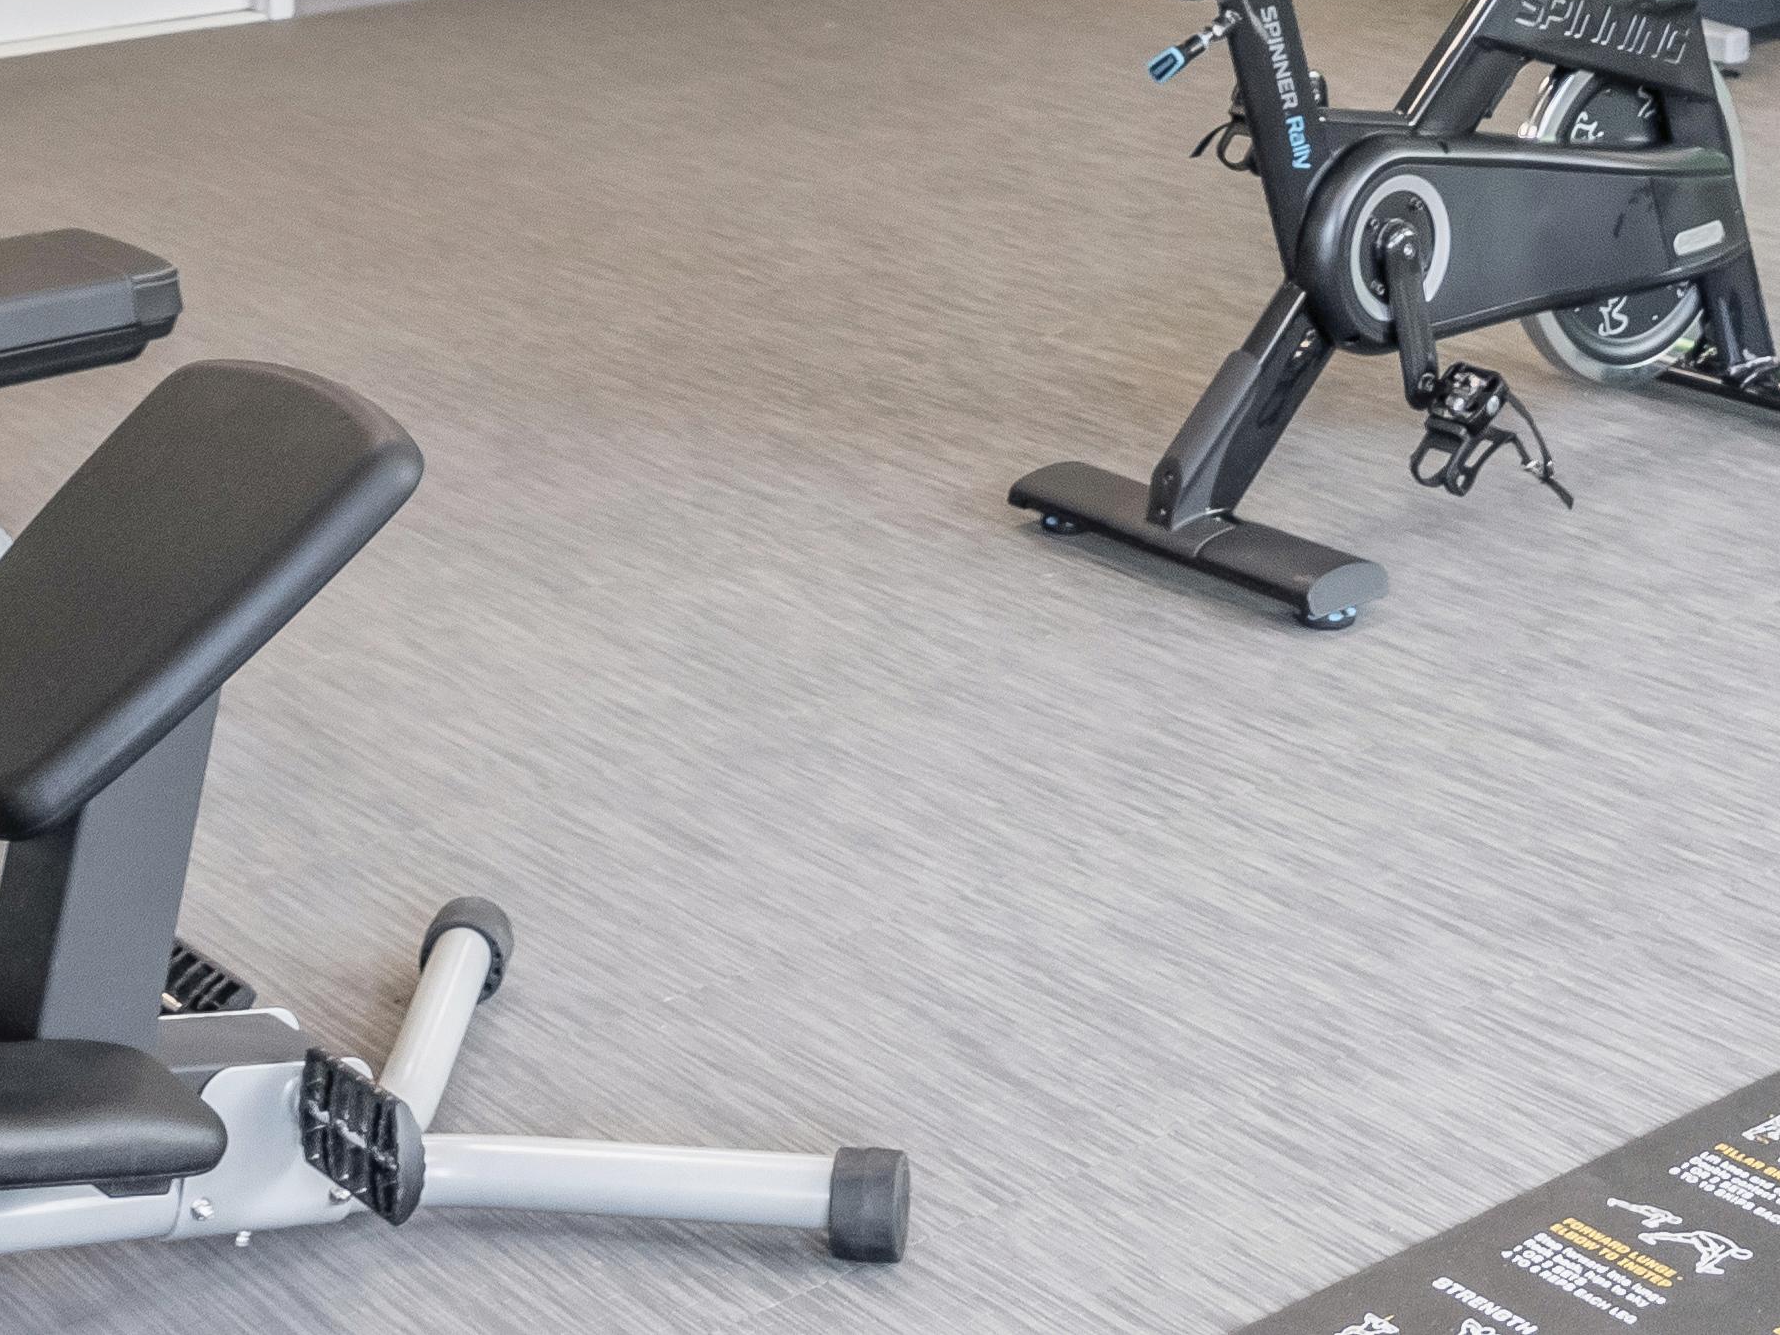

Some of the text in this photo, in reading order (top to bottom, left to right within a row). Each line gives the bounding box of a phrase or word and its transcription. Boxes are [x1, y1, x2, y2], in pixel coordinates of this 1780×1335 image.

[1260, 5, 1312, 170] SPINNER Rally
[1714, 1143, 1766, 1170] PILLAR
[1549, 1223, 1601, 1250] ELBOW
[1598, 1246, 1620, 1261] TO
[1617, 1257, 1673, 1287] INSTEP
[1562, 1217, 1631, 1254] FORWARD
[1432, 1276, 1539, 1335] STRENGTH
